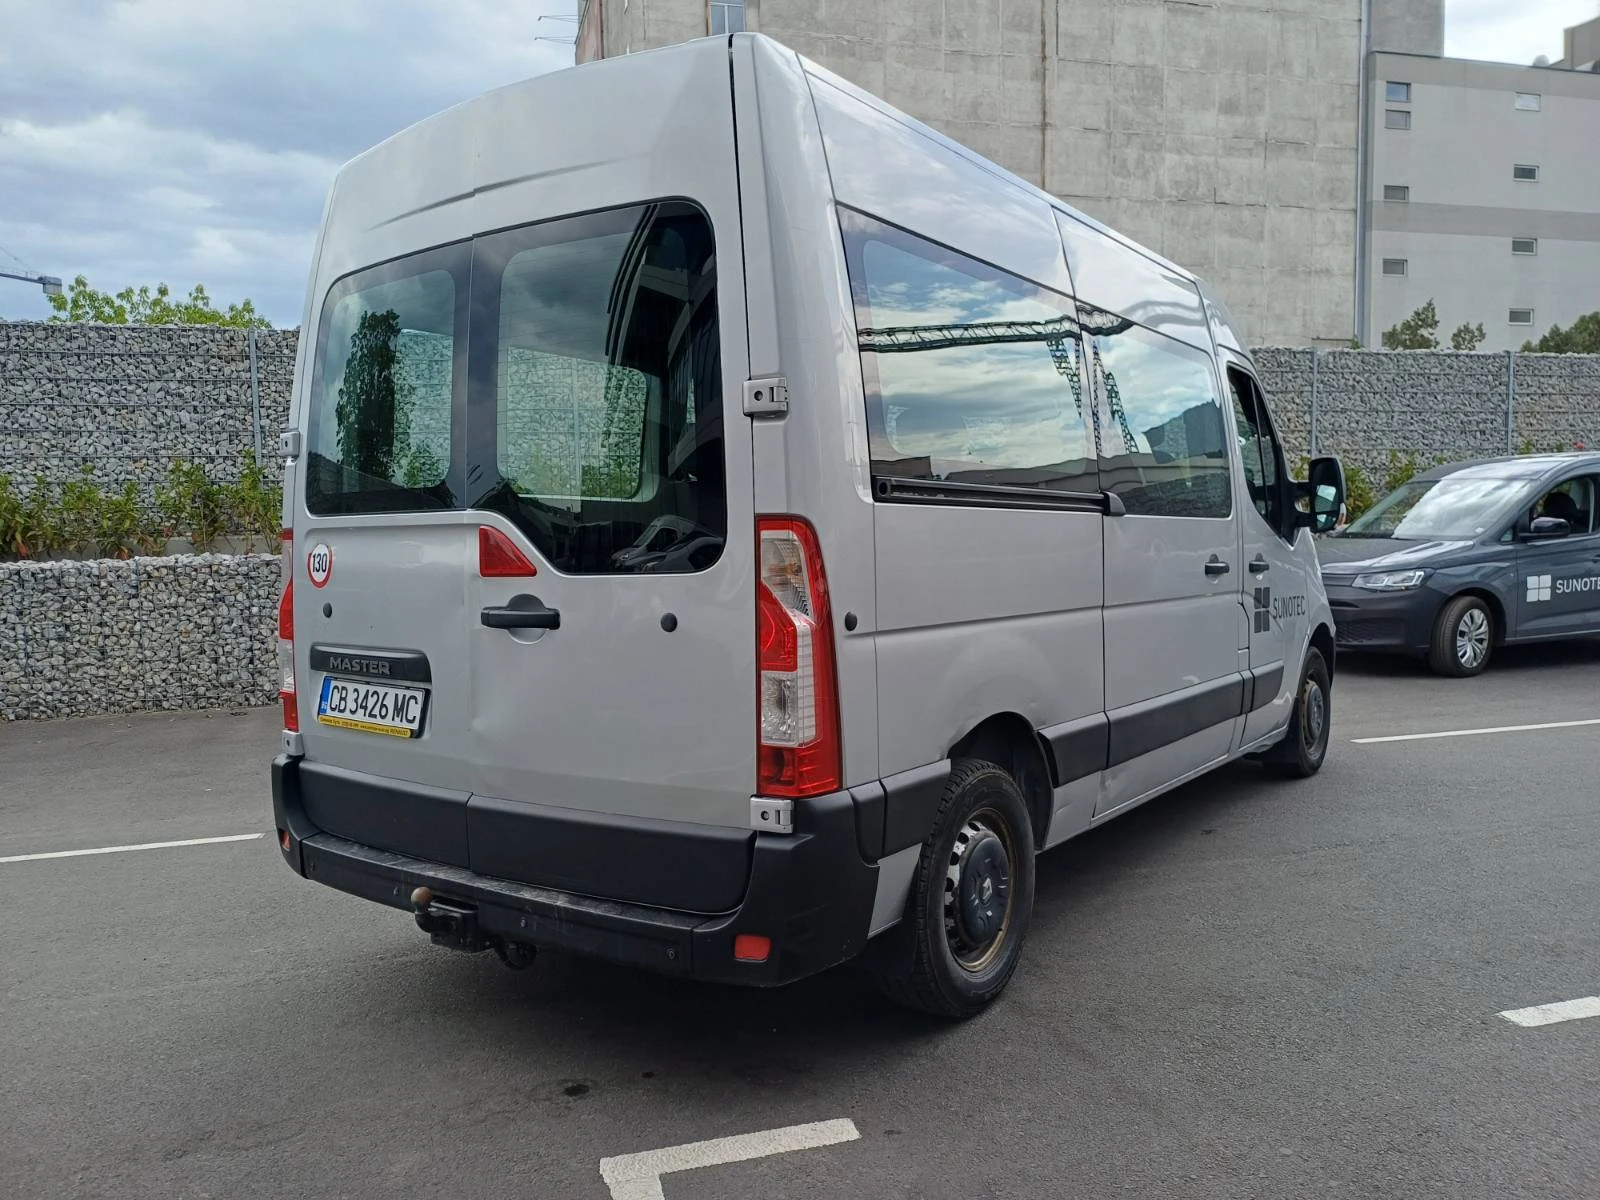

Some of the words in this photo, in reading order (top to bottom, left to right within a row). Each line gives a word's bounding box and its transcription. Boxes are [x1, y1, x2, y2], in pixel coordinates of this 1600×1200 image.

[312, 553, 328, 573] 130
[1272, 595, 1305, 619] SUNOTEC
[330, 656, 390, 675] MASTER
